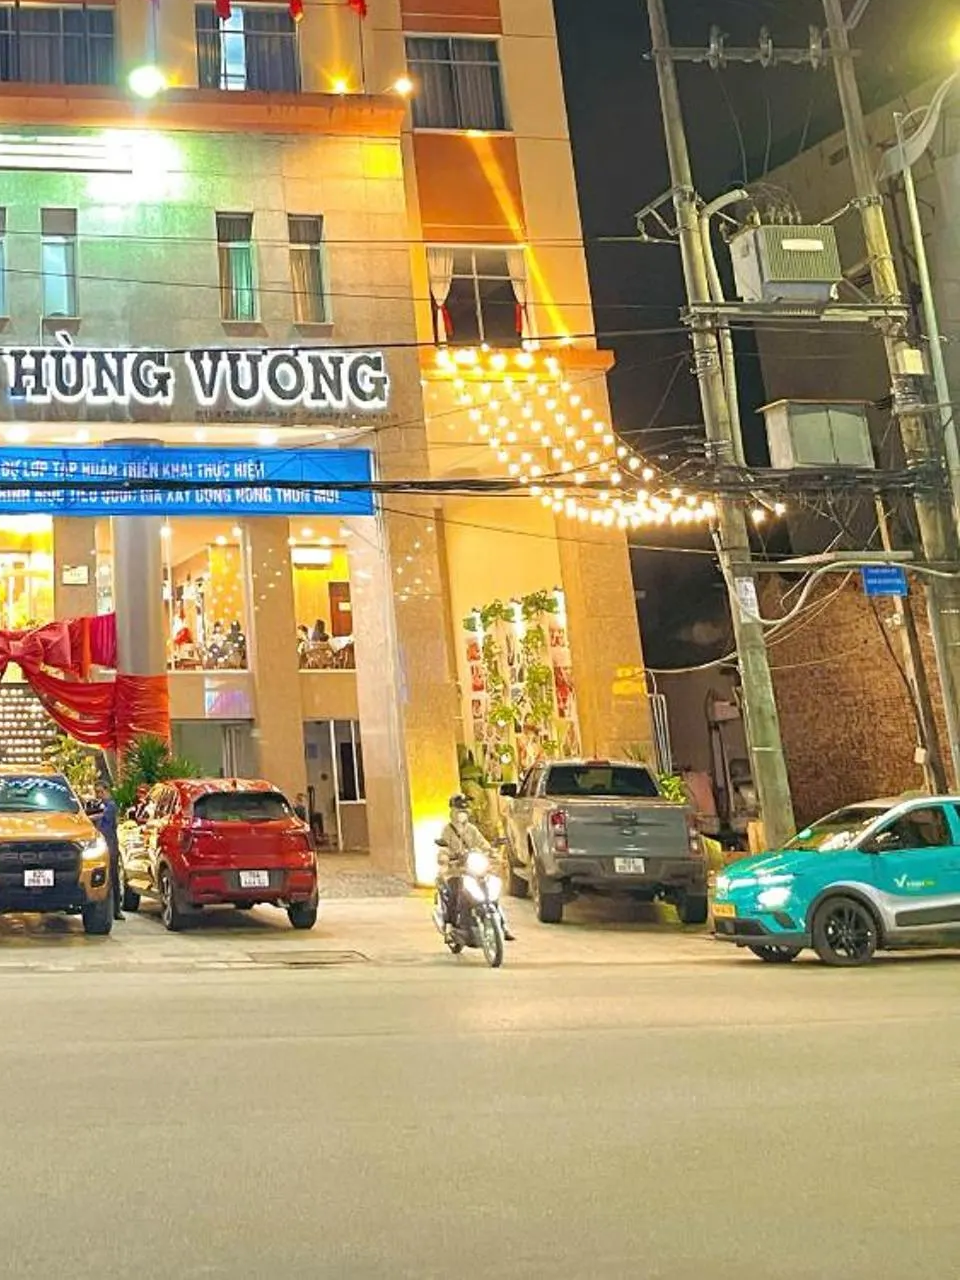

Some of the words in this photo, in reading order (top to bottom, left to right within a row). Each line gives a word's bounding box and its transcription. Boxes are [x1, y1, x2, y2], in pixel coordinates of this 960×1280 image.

[5, 332, 174, 402] HÙNG
[187, 347, 389, 407] VƯƠNG
[162, 460, 193, 478] KHAI
